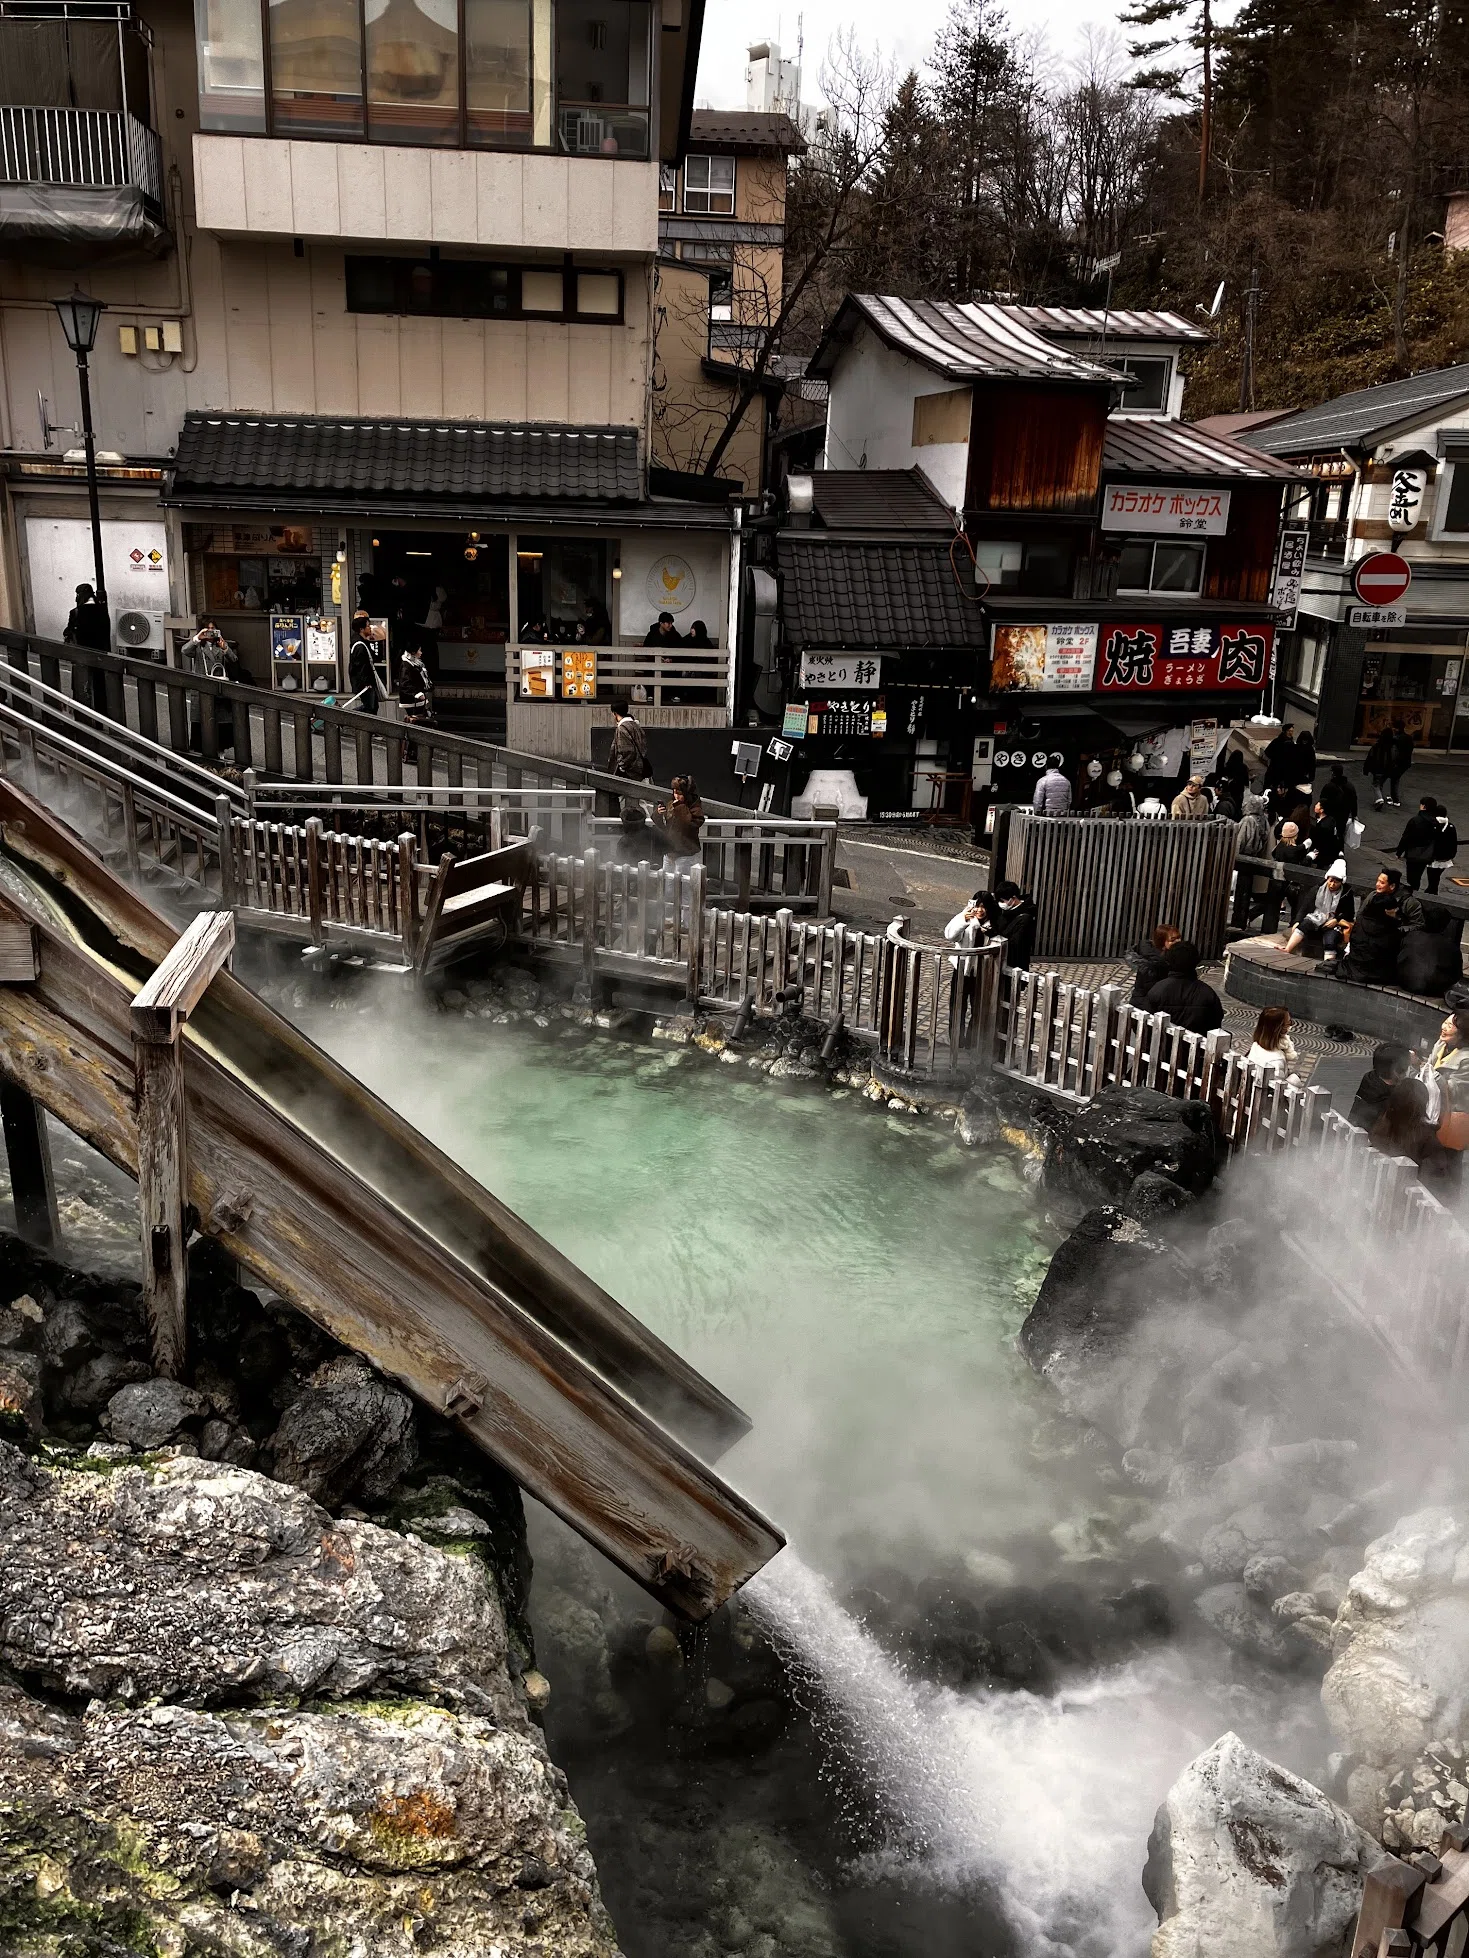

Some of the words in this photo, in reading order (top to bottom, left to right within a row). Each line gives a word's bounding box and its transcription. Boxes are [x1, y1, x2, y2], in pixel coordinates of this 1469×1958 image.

[1110, 491, 1167, 514] カラオケ
[1169, 493, 1222, 516] ボックス
[1391, 471, 1422, 526] 釜めし
[1179, 517, 1207, 530] 鈴堂
[1281, 540, 1295, 570] 居酒屋
[1290, 536, 1305, 577] ちょい飲み
[1353, 611, 1403, 624] 自転車を除く
[1051, 625, 1074, 635] カラオケ
[1073, 625, 1095, 636] ボックス
[1079, 637, 1090, 645] 2F
[1169, 627, 1213, 655] 吾妻
[807, 655, 834, 666] 炭火焼
[1102, 629, 1157, 686] 焼
[1217, 628, 1266, 685] 肉
[804, 668, 848, 685] やきとり
[853, 659, 877, 685] 静
[1165, 662, 1206, 674] ラーメン
[1163, 674, 1206, 686] ぎょうざ
[828, 700, 870, 714] やきとり
